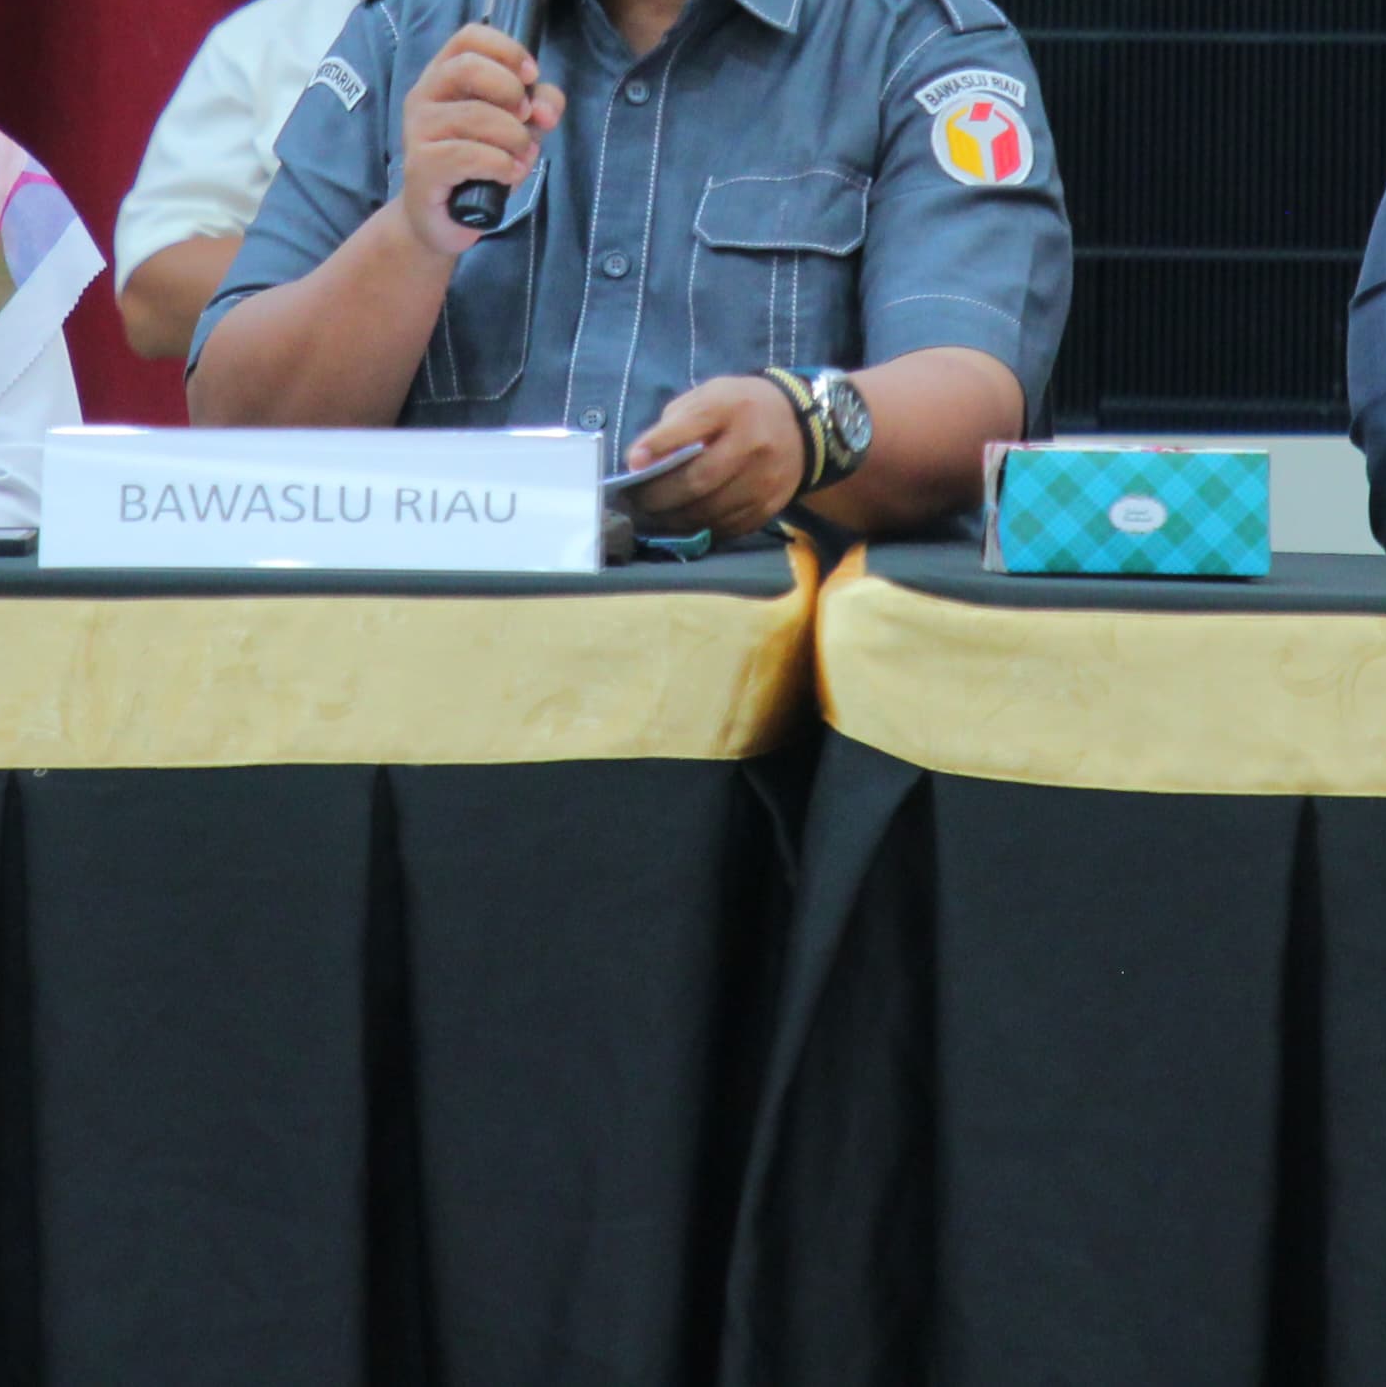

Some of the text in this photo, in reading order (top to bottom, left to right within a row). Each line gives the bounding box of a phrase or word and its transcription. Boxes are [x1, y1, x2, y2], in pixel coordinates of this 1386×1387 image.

[925, 75, 1021, 106] BAWASLU RIAU
[119, 483, 516, 523] BAWASLU RIAU
